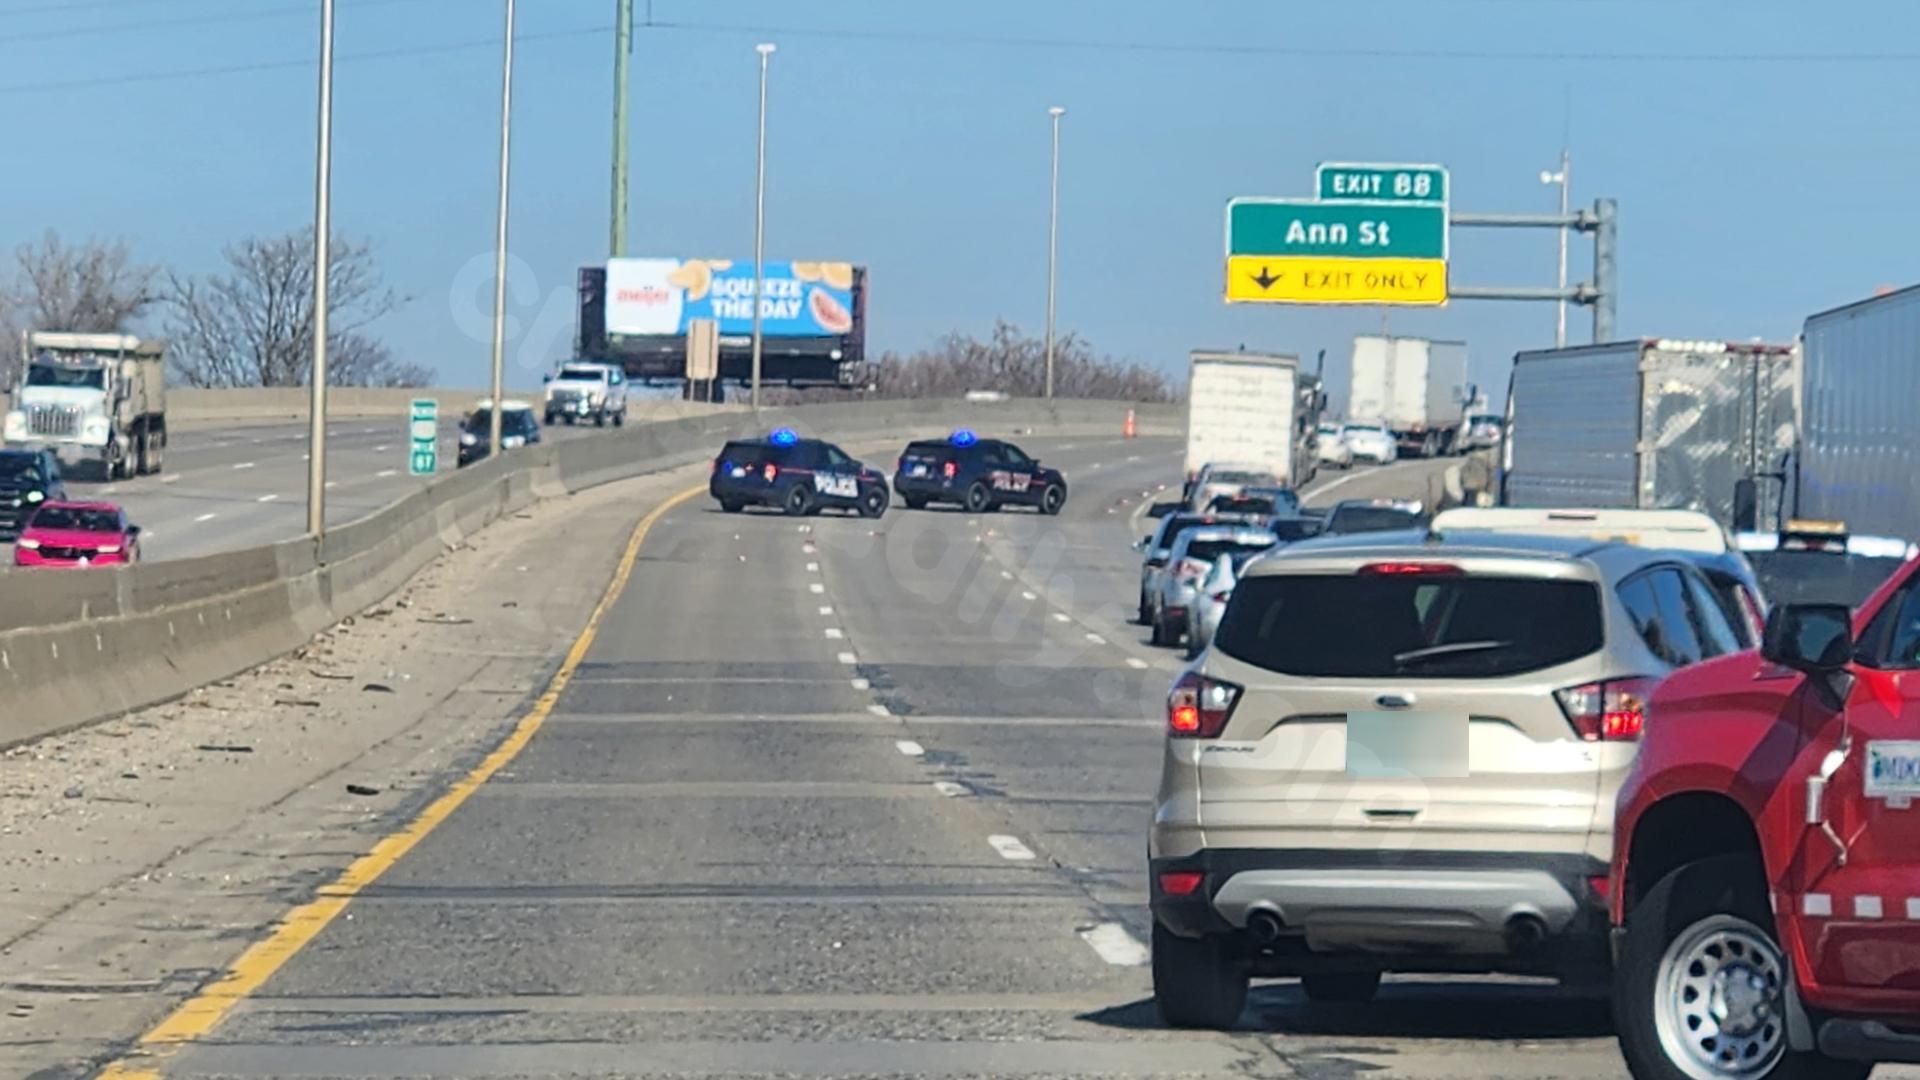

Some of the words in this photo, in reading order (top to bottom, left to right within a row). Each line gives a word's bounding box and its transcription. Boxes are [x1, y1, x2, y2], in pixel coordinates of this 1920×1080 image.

[1333, 174, 1382, 194] EXIT
[1393, 173, 1432, 197] 88
[1285, 219, 1348, 245] Ann
[1358, 220, 1390, 246] St
[1303, 271, 1352, 290] EXIT
[1364, 271, 1428, 290] ONLY
[710, 299, 755, 319] THE
[760, 299, 802, 320] DAY
